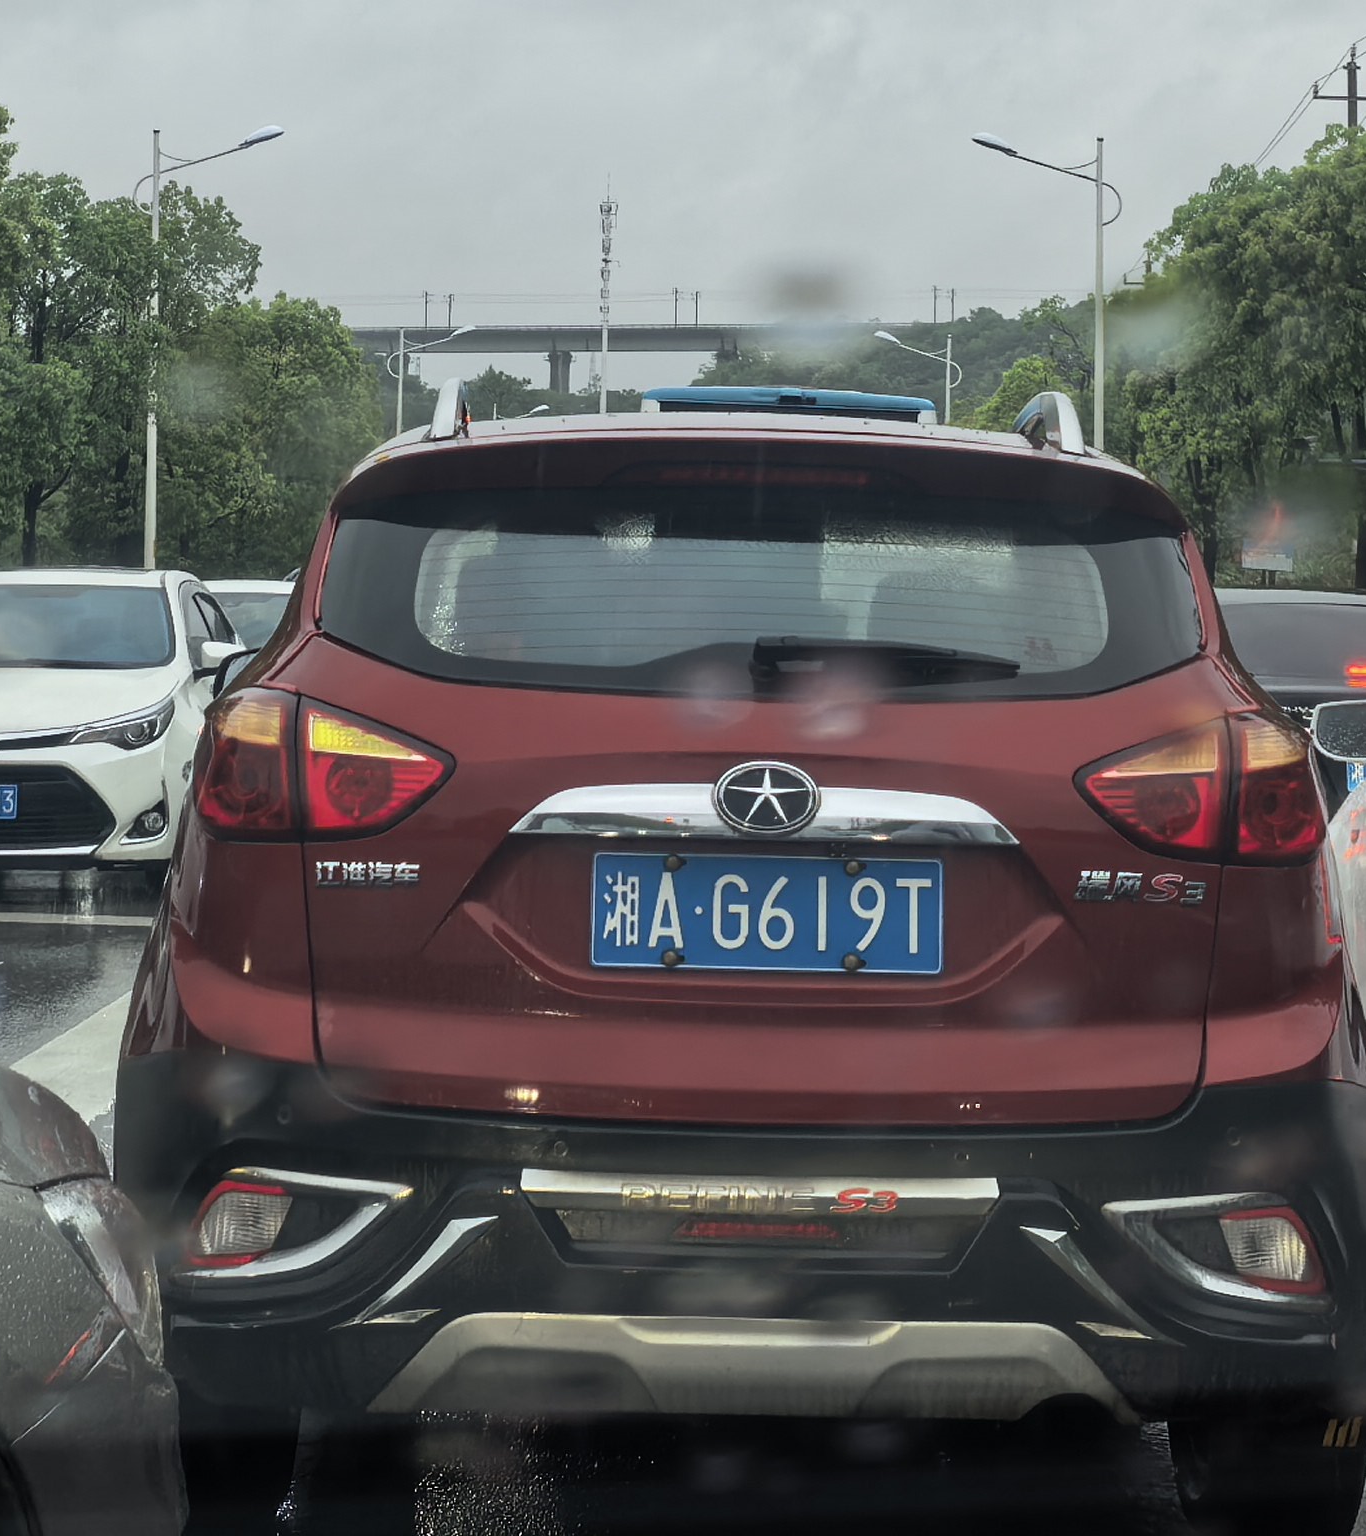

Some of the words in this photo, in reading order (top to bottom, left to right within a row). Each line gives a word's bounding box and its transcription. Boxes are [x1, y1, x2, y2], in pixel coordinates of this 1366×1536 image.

[315, 861, 420, 884] 江淮汽车
[1143, 872, 1207, 904] S3
[603, 870, 933, 955] 湘A·G619T
[829, 1187, 900, 1214] S3
